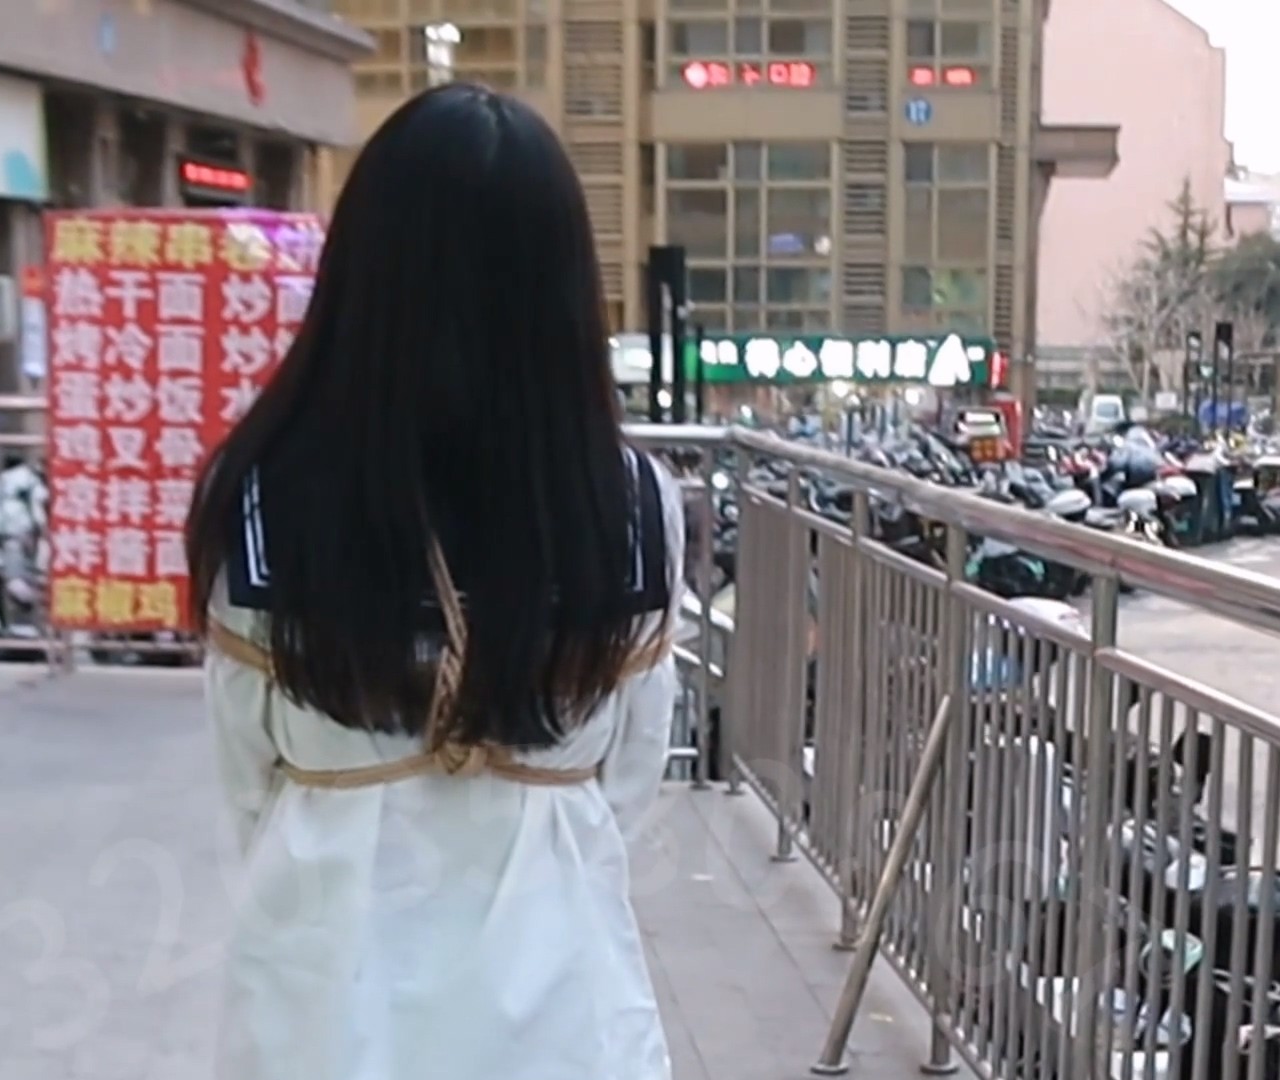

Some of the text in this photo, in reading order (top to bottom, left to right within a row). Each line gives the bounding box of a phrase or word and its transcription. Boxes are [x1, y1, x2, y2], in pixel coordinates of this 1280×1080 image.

[54, 268, 206, 322] 热干面
[53, 320, 205, 371] 烤冷面
[54, 371, 204, 423] 蛋炒饭
